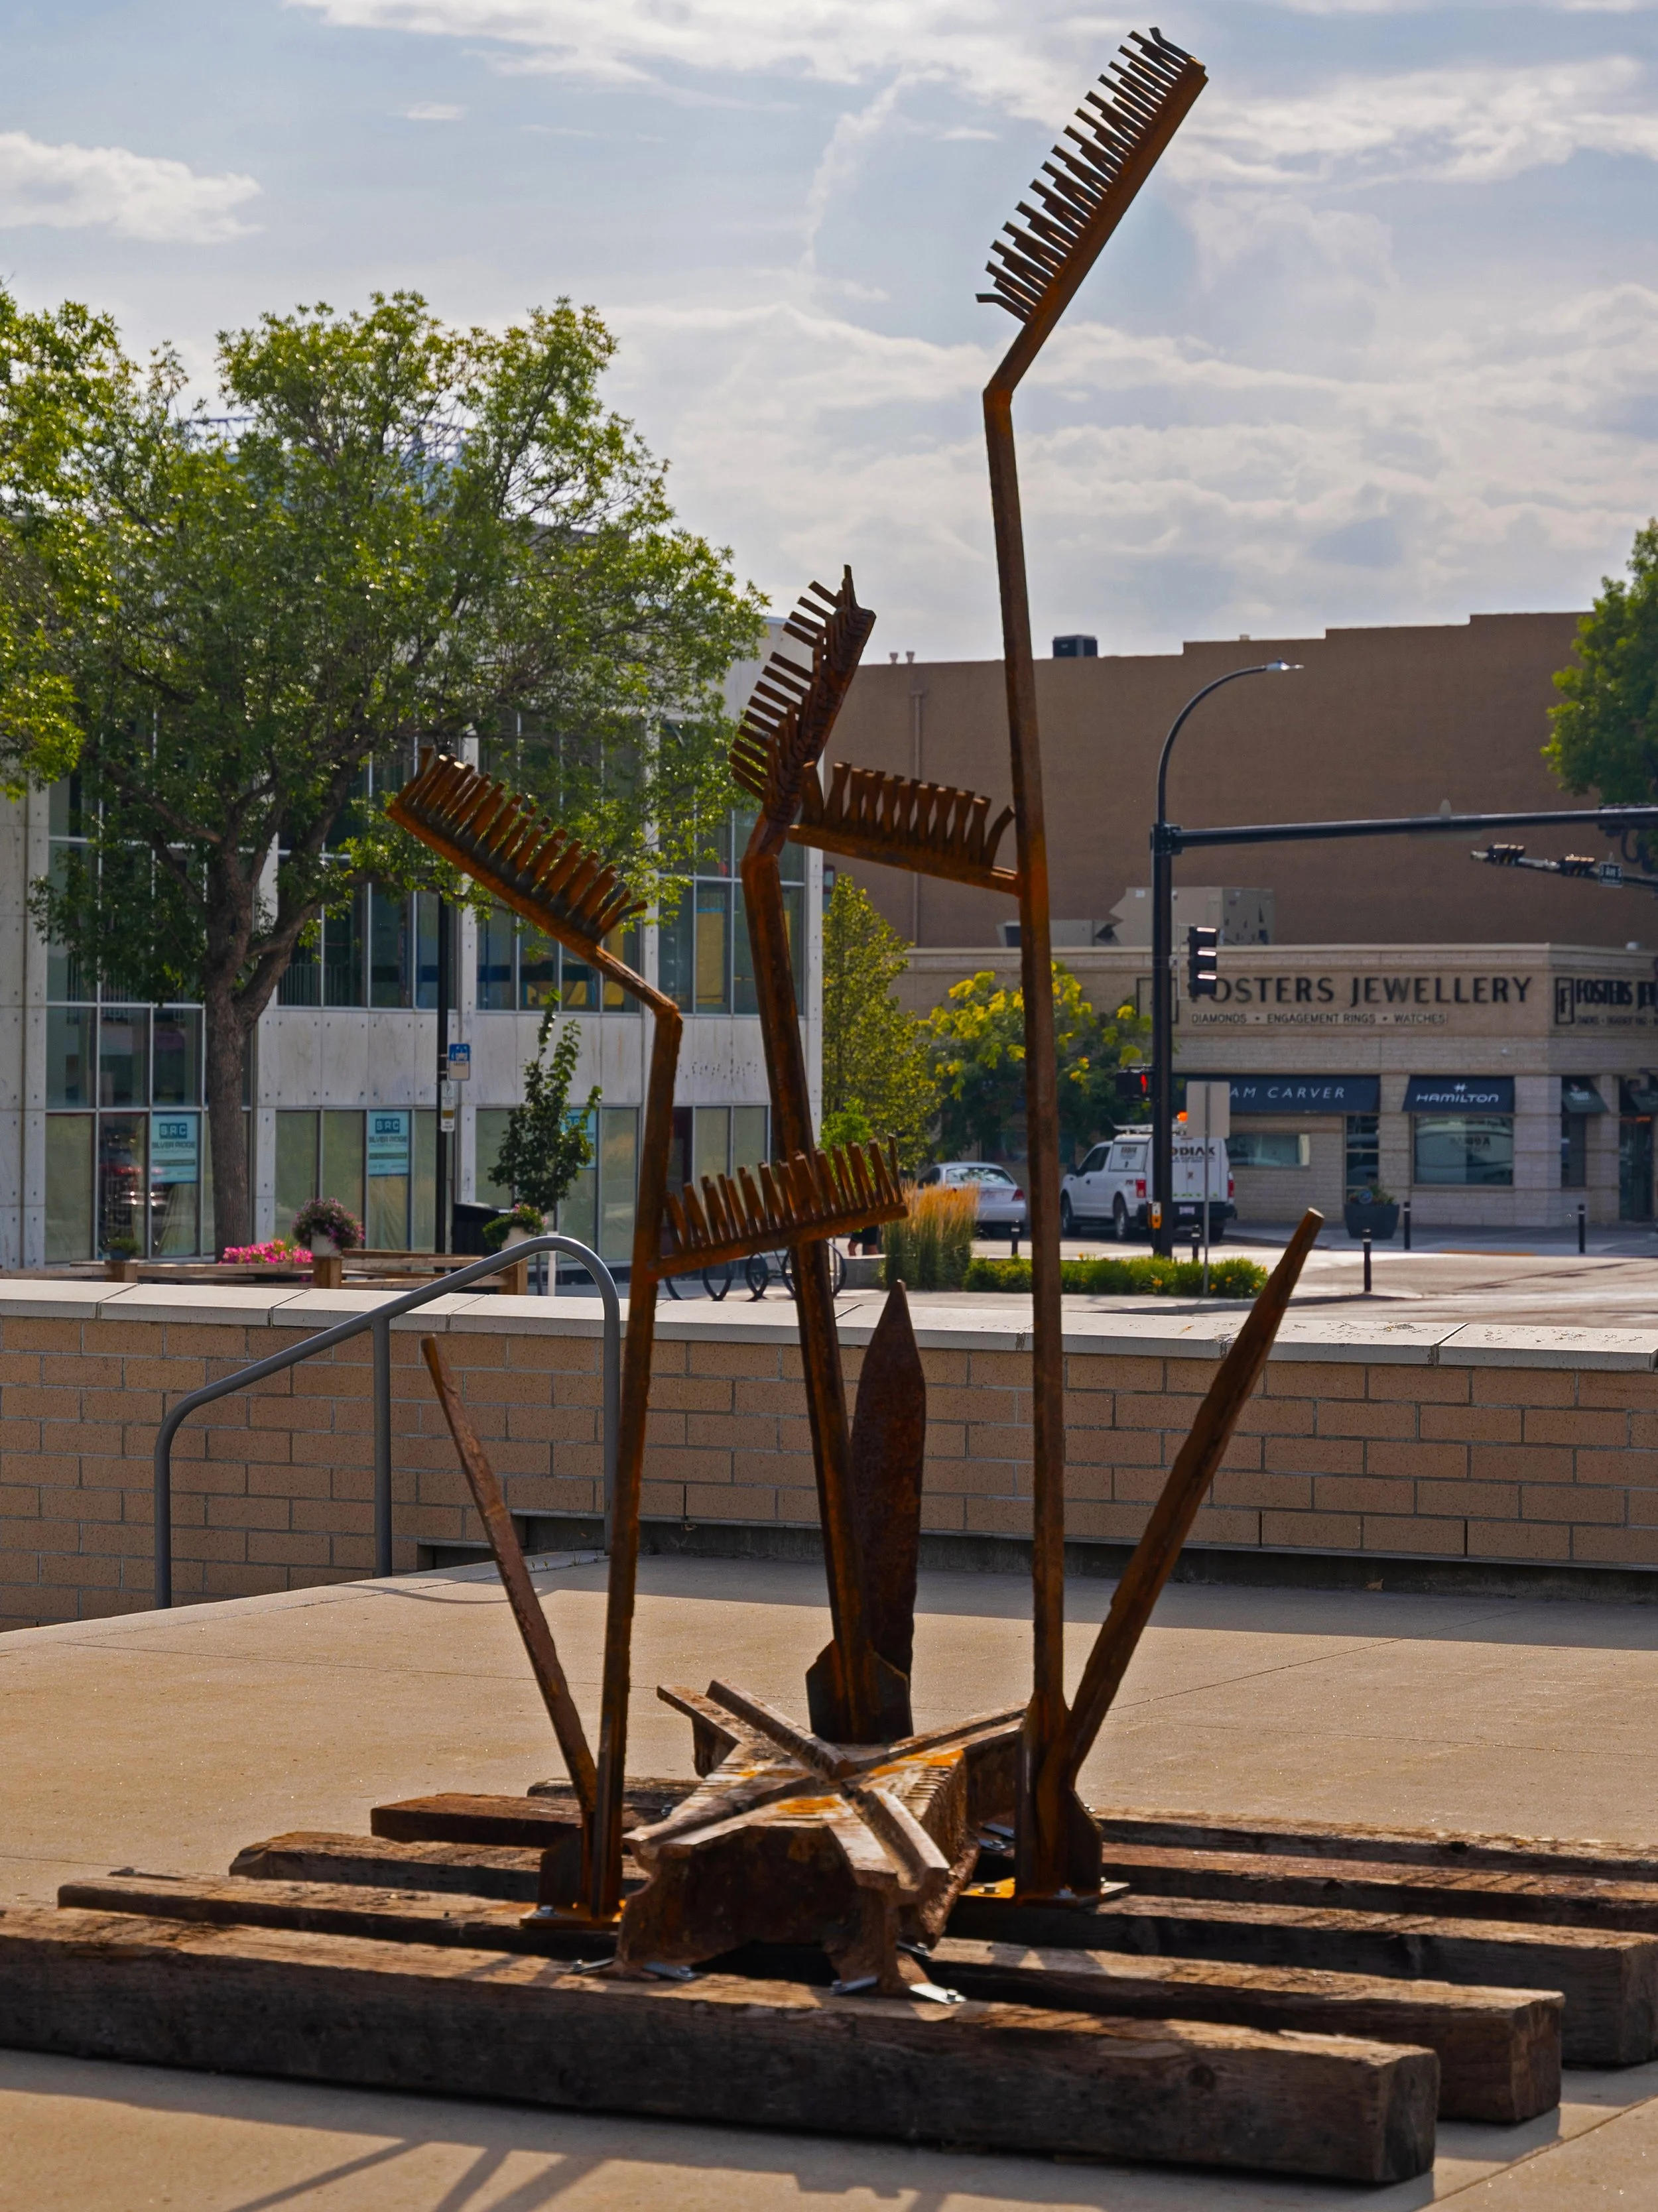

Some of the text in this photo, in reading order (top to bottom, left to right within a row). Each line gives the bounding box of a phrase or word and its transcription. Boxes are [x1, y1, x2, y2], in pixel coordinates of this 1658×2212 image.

[1192, 976, 1533, 1008] OSTERS JEWELLERY
[1191, 1013, 1445, 1024] DIAMONDS ENGAGEMENT RINGS WATCHES
[1230, 1086, 1345, 1099] AM CARVER
[1415, 1093, 1499, 1103] HAMILTON
[1171, 1146, 1216, 1156] ODIAK
